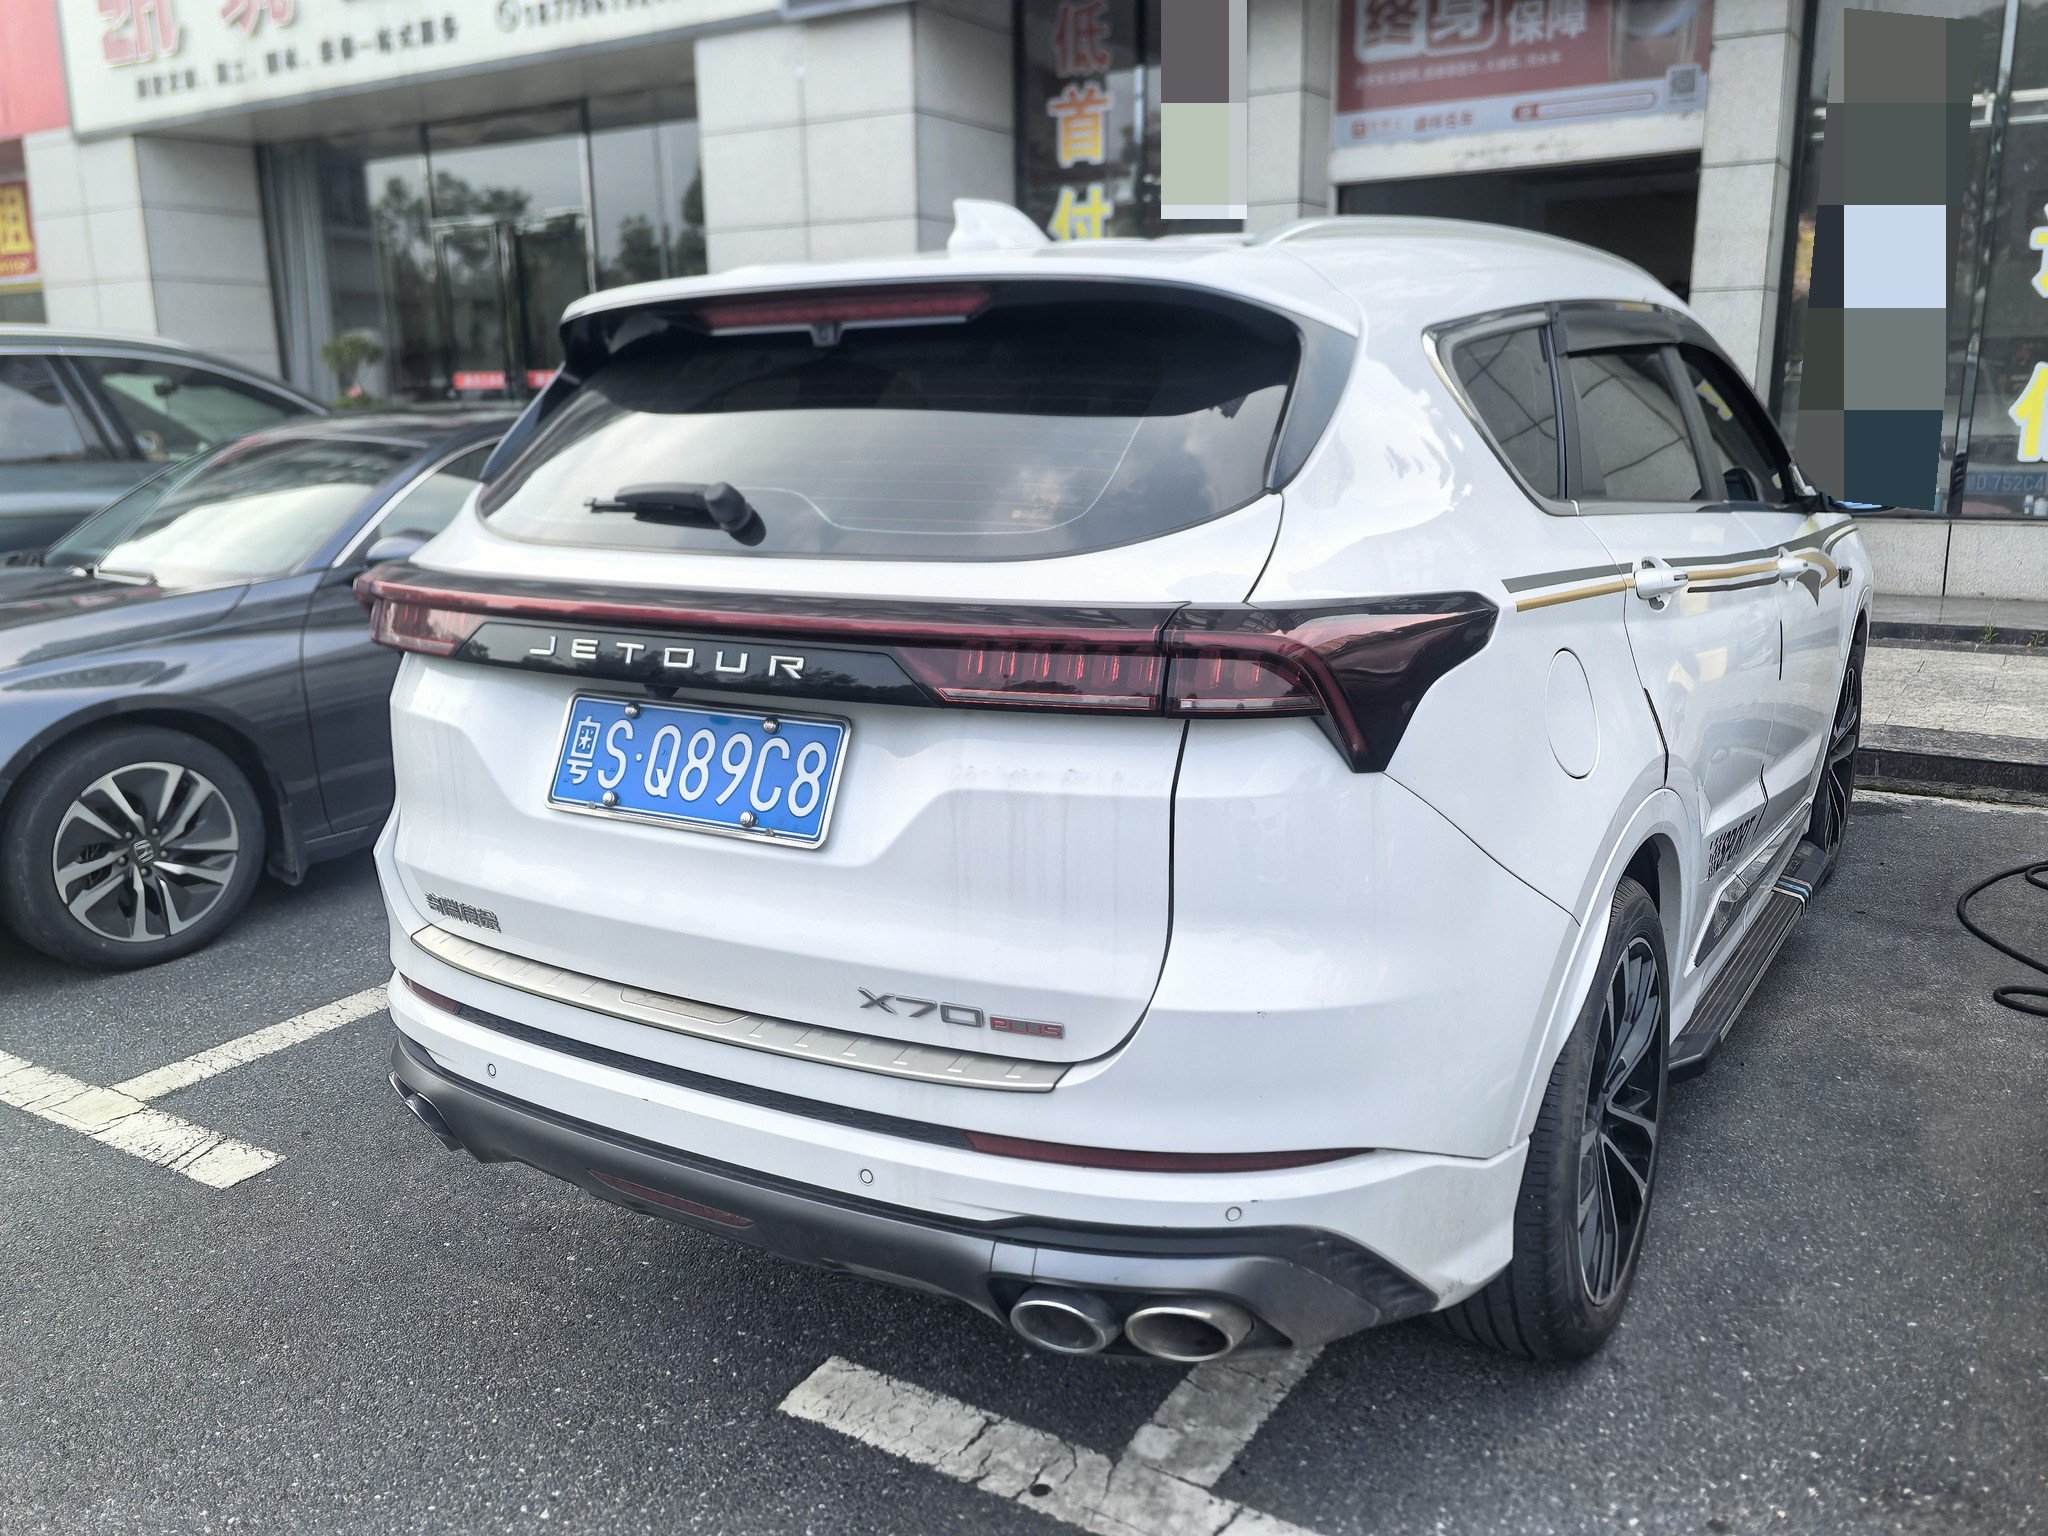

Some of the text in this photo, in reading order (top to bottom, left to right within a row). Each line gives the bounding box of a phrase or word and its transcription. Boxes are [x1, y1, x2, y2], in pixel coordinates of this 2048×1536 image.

[529, 635, 806, 680] JETOUR
[563, 715, 829, 819] 粤S·Q89C8
[857, 987, 1065, 1040] X70 PLUS
